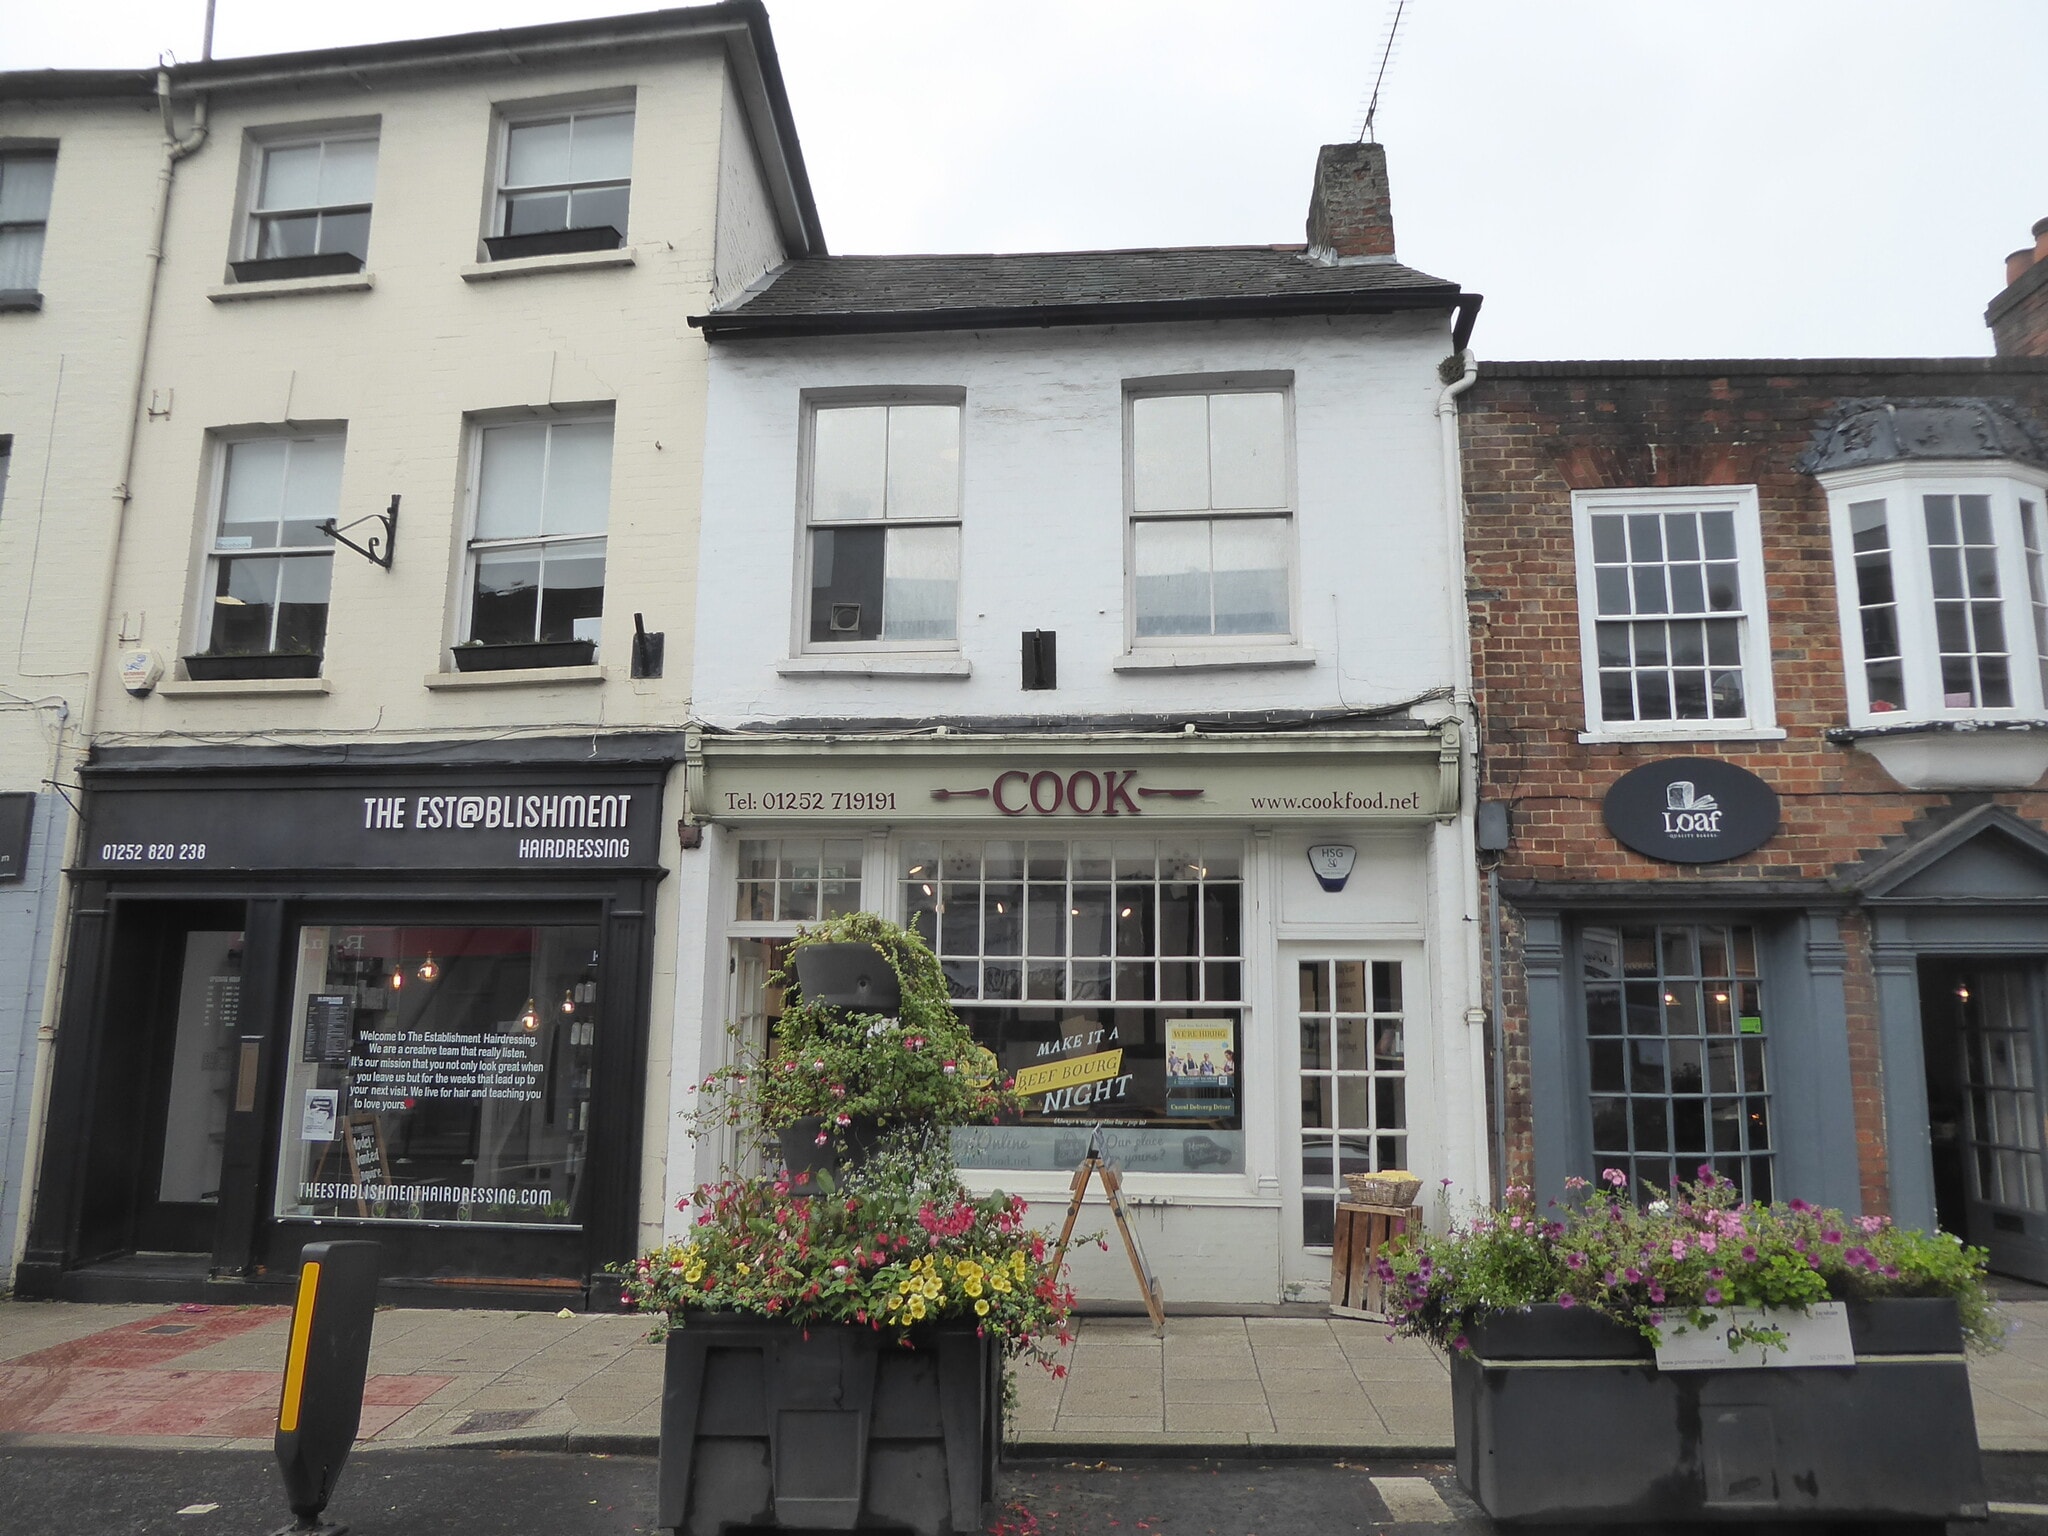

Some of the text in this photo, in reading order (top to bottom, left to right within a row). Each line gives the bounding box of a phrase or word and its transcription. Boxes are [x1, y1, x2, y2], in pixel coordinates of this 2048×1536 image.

[725, 791, 896, 810] Tel: 01252 719191
[993, 770, 1142, 815] COOK
[1251, 790, 1420, 810] www.cookfood.net
[365, 795, 631, 829] THE EST@BLISHMENT
[1661, 810, 1723, 833] Loaf
[103, 843, 206, 860] 01252 820 238
[519, 838, 630, 859] HAIRDRESSING
[1321, 848, 1344, 858] HSG
[360, 1030, 538, 1047] Welcome to The Establishment Hairdressing.
[1036, 1026, 1119, 1057] MAKE IT A
[369, 1043, 527, 1059] We are a creative team that really listen.
[351, 1056, 543, 1073] It's our mission that you not only look great when
[1018, 1056, 1117, 1088] BEEF BOURG
[357, 1071, 536, 1087] you leave us but for the weeks that lead up to
[349, 1086, 542, 1101] your next visit. We live for hair and teaching you
[1042, 1073, 1133, 1114] NIGHT
[354, 1098, 407, 1112] to love yours.
[1190, 1103, 1212, 1112] Delivery
[299, 1181, 552, 1206] THEESTABLISHMENTHAIRDRESSING.COM
